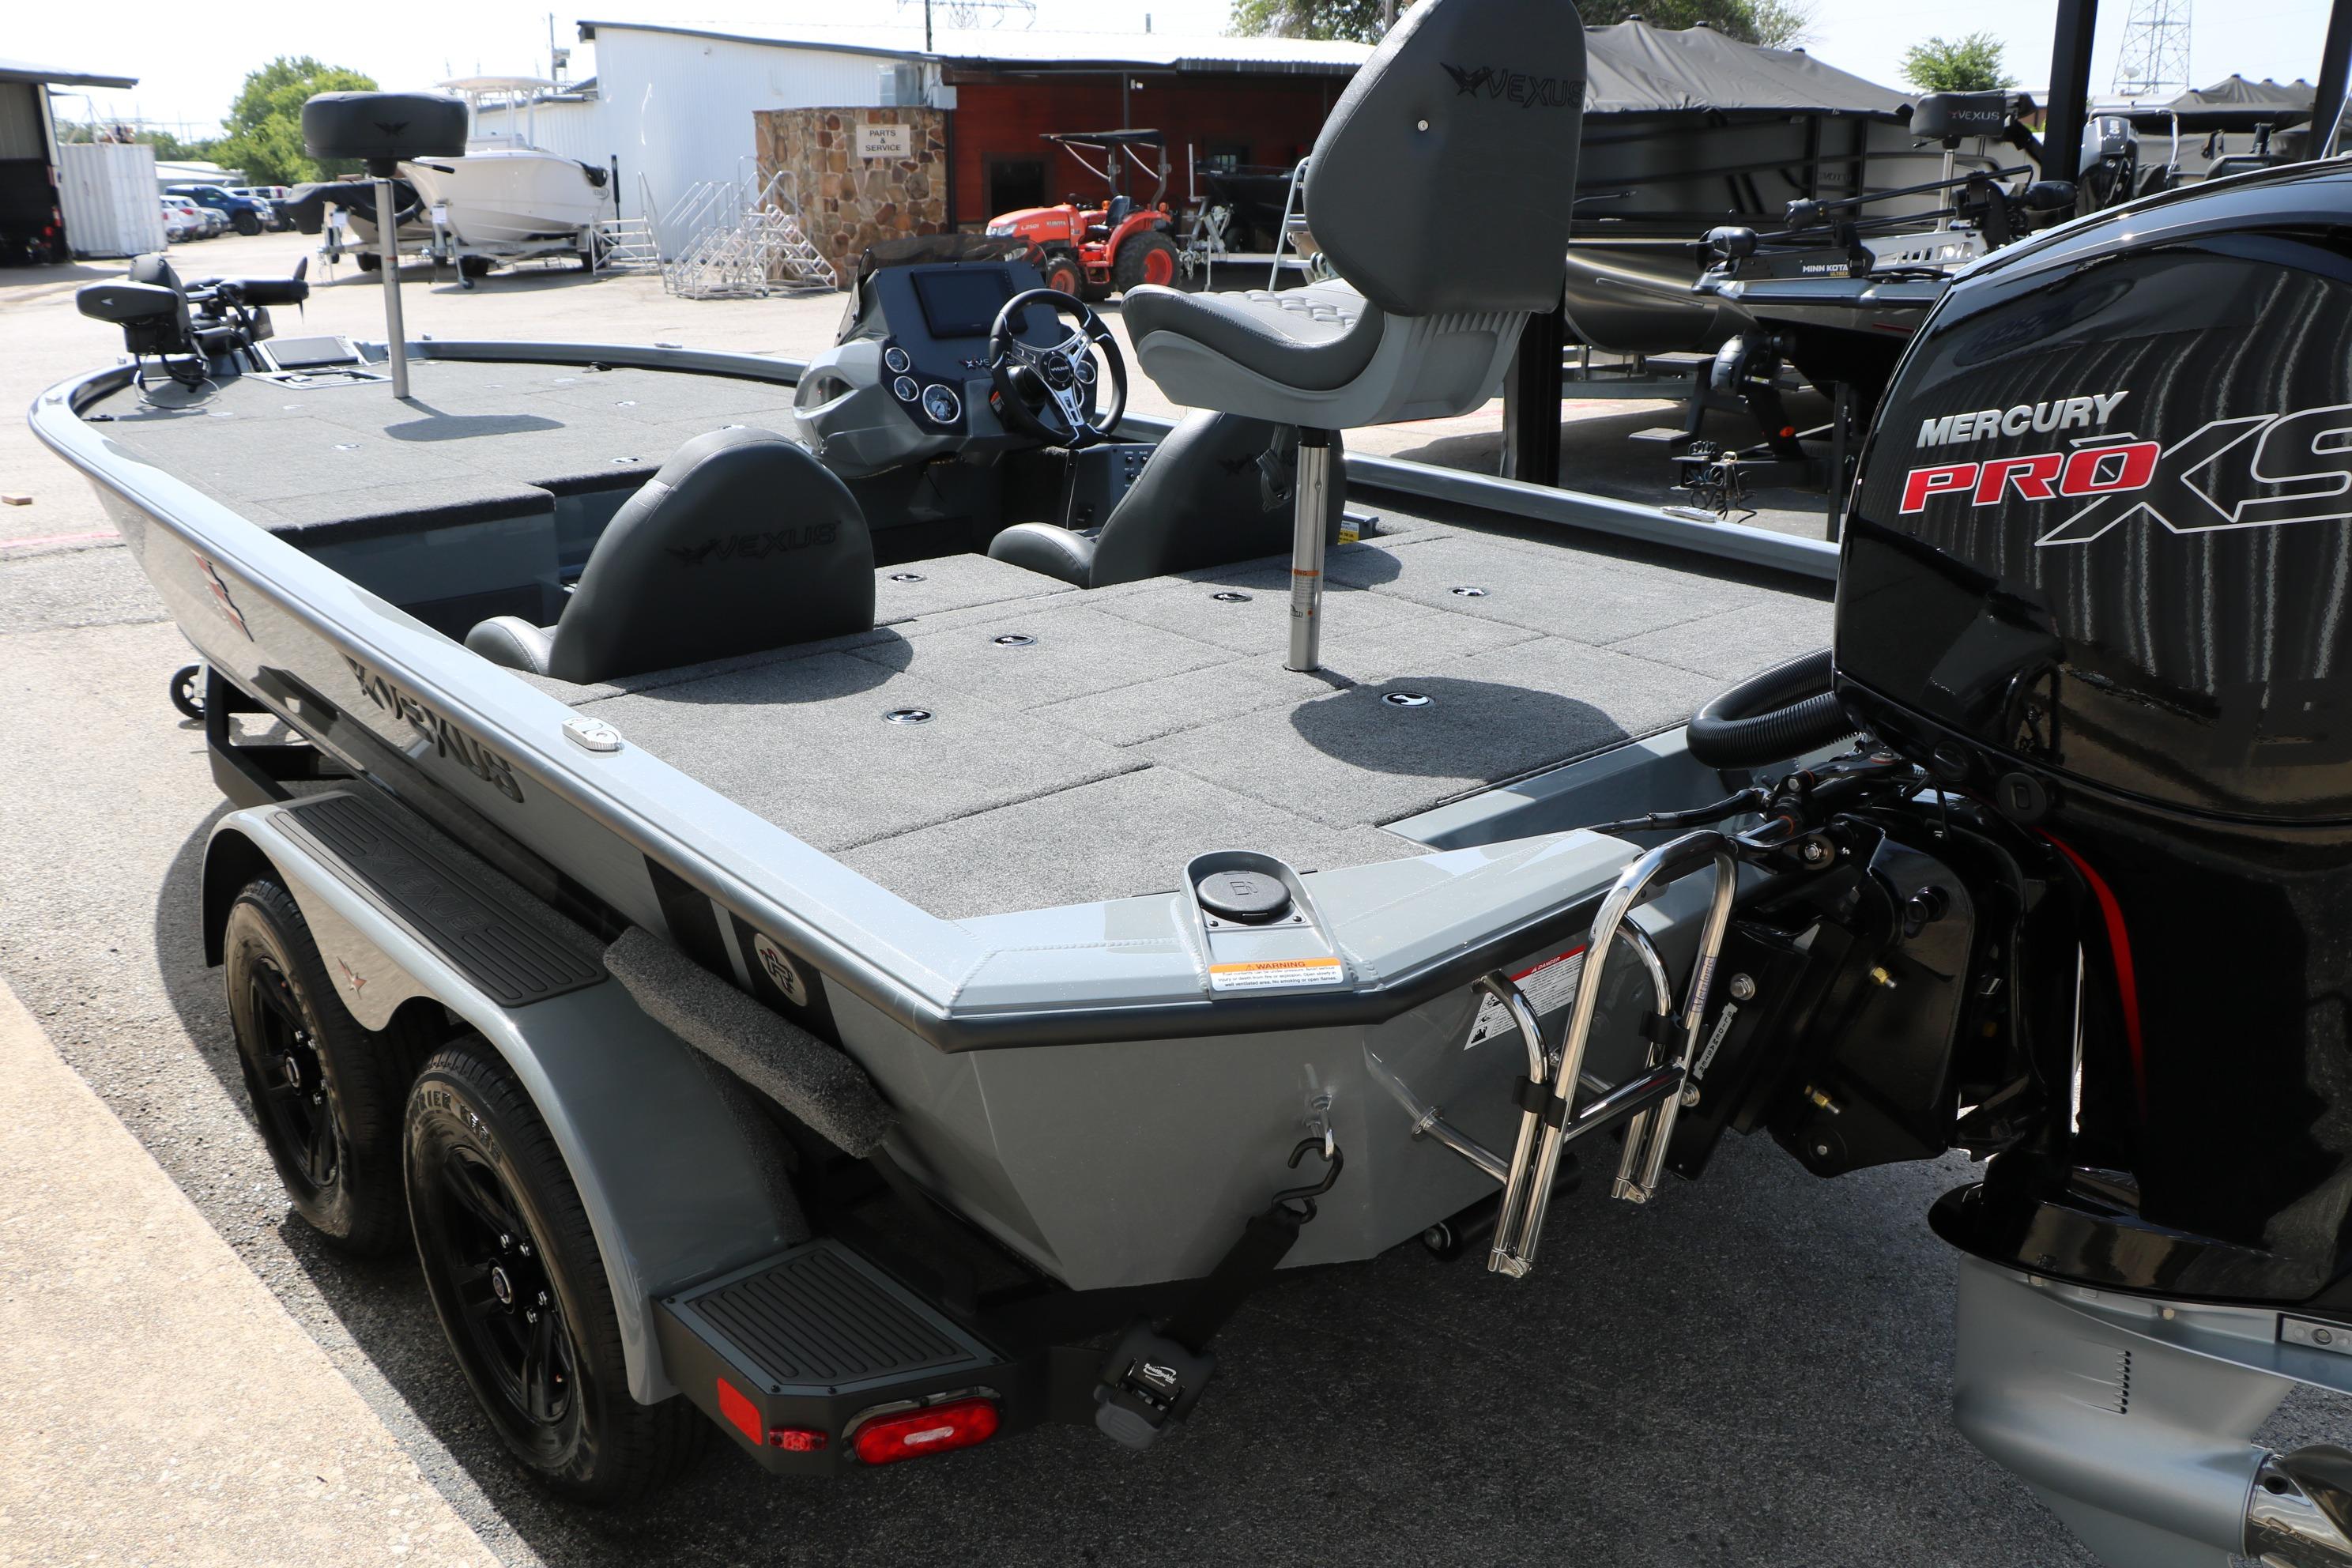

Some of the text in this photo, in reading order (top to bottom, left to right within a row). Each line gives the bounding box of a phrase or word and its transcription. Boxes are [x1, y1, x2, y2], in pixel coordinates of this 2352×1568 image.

[1484, 66, 1584, 109] VEXUS
[1958, 109, 2000, 120] VEXUS
[1917, 391, 2129, 448] MERCURY
[1899, 441, 2162, 514] PRO
[714, 523, 836, 560] VEXUS
[368, 674, 525, 803] VEXUS
[382, 865, 488, 931] VEXUS
[1537, 956, 1561, 971] DANGER
[1698, 1011, 1732, 1072] SLIDEMASTER
